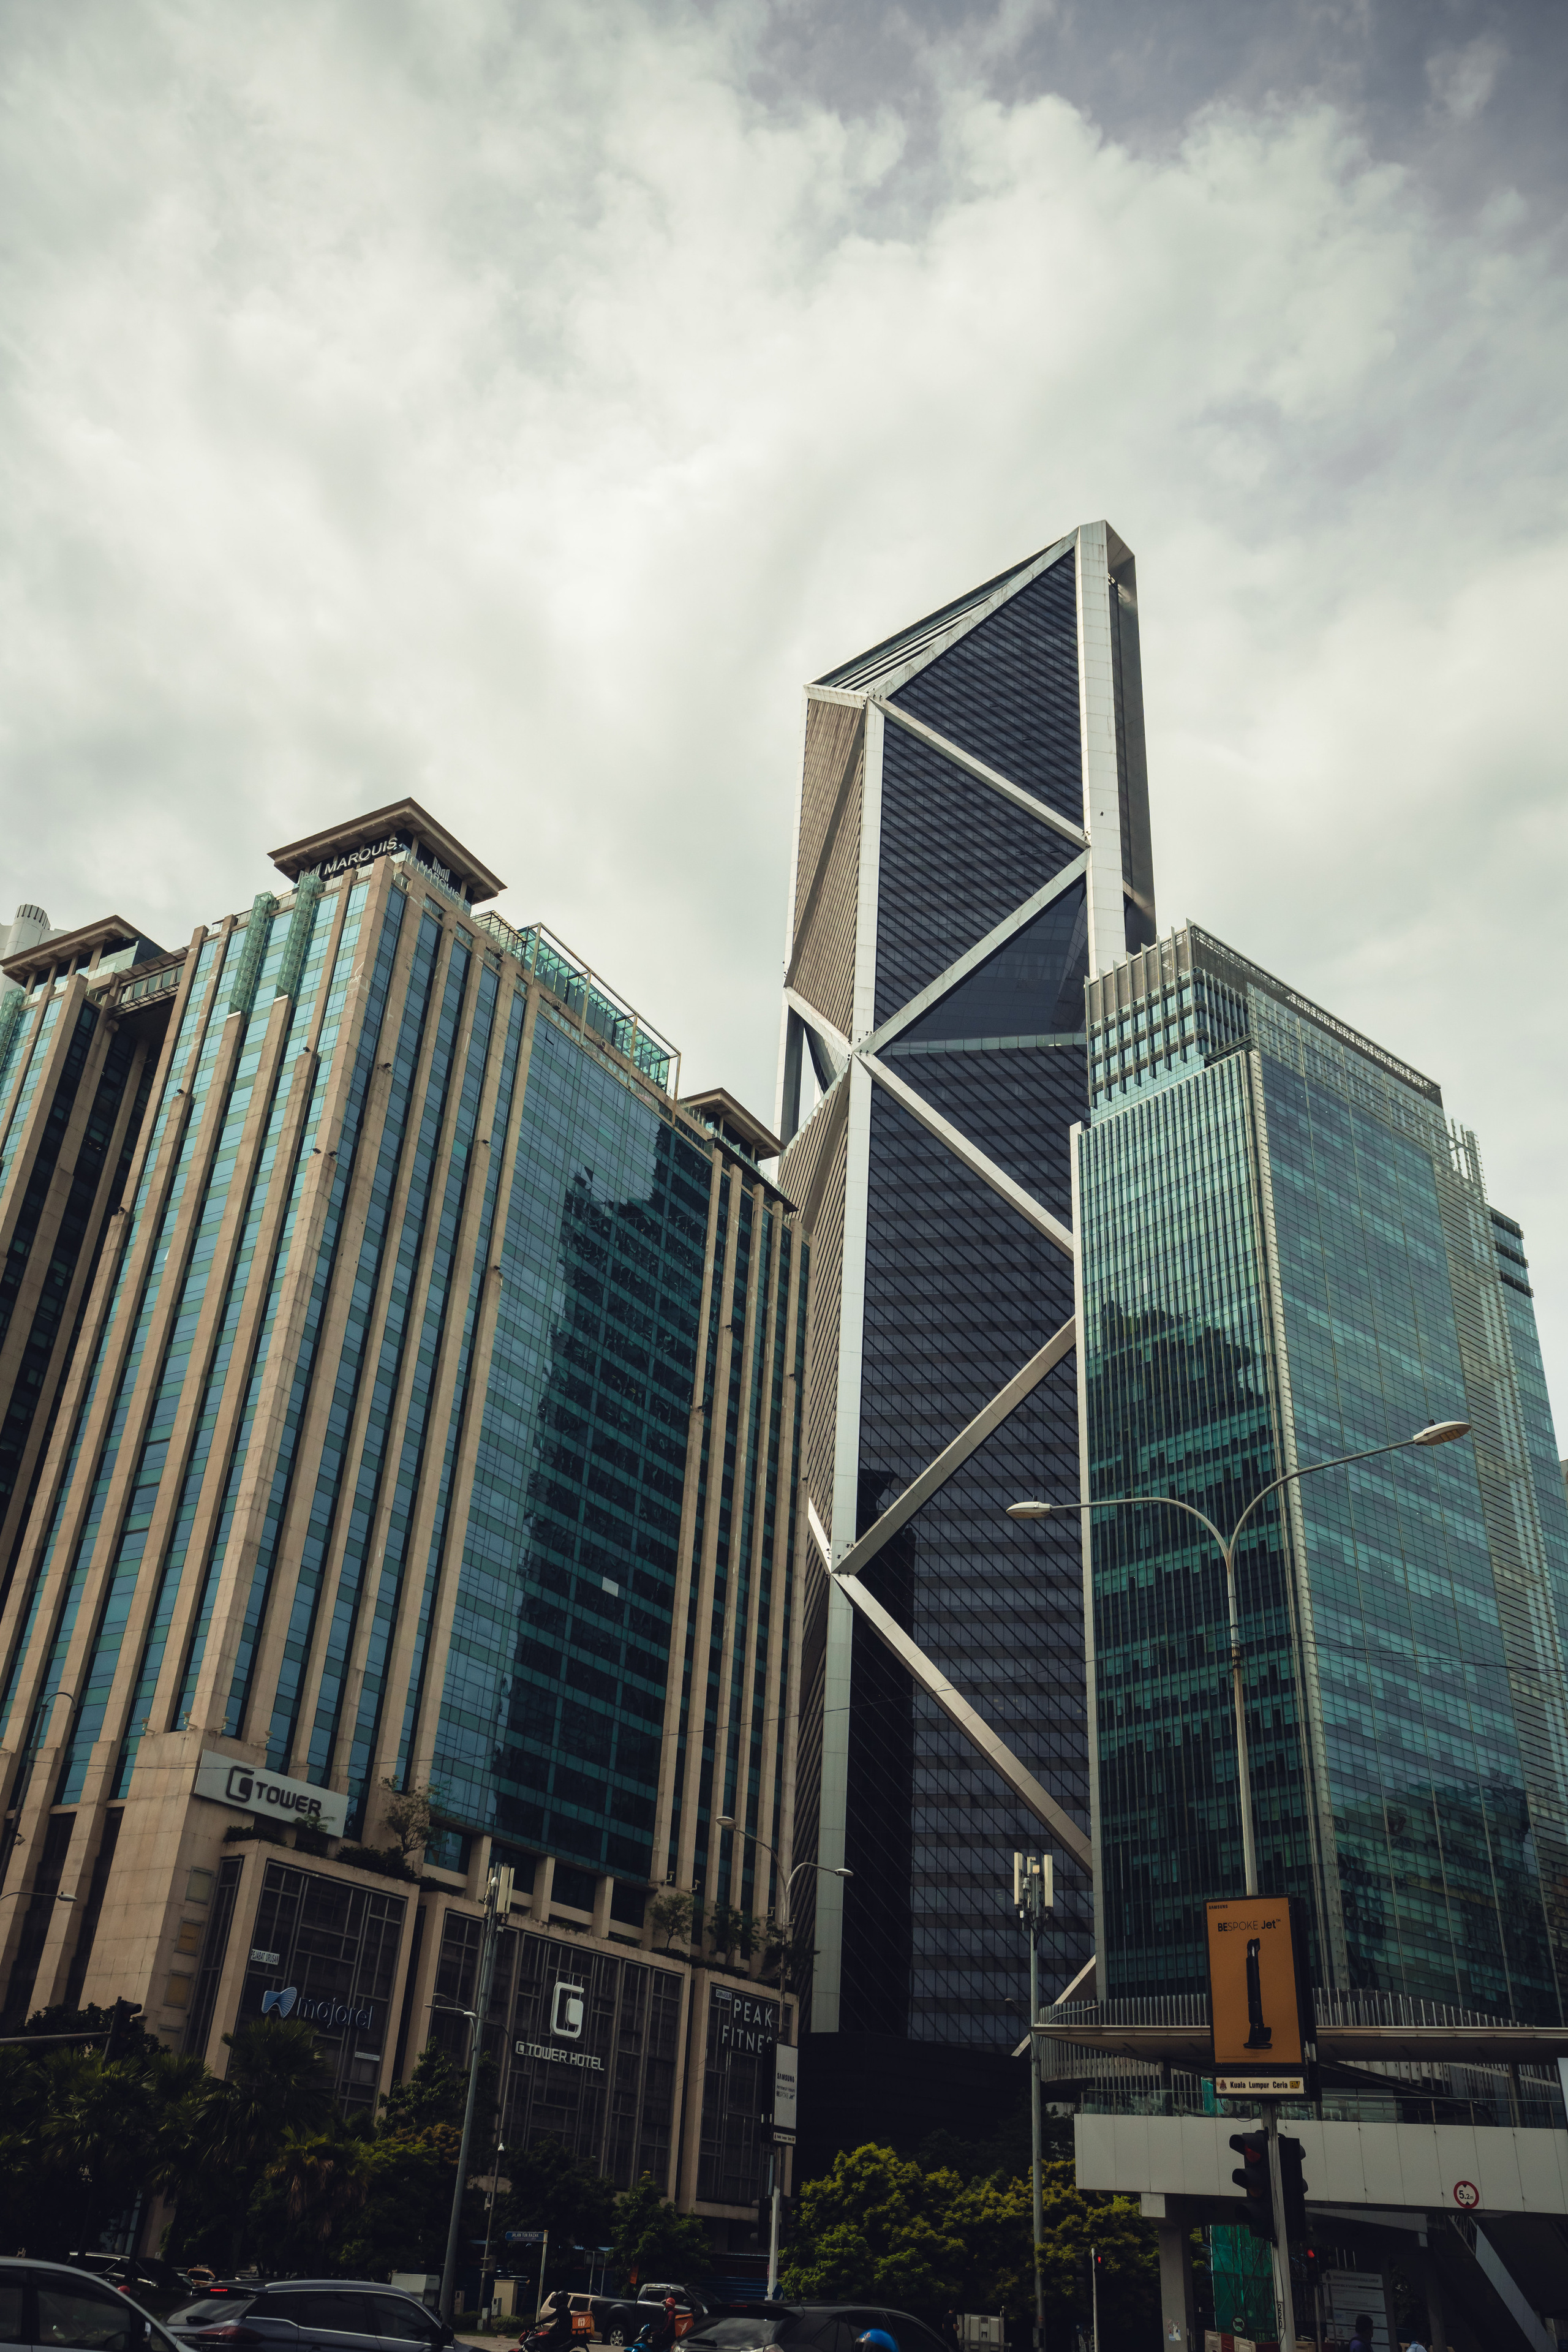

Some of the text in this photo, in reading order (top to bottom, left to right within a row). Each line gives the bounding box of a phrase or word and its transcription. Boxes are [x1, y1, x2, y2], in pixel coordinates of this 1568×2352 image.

[325, 837, 398, 875] MARQUIS
[1218, 1921, 1258, 1932] BESPOKE
[296, 1997, 375, 2030] majorel
[734, 1999, 772, 2027] PEAK
[570, 2052, 605, 2071] HOTEL
[777, 2073, 794, 2082] SAMSUNG
[1249, 2081, 1269, 2090] Lumpur
